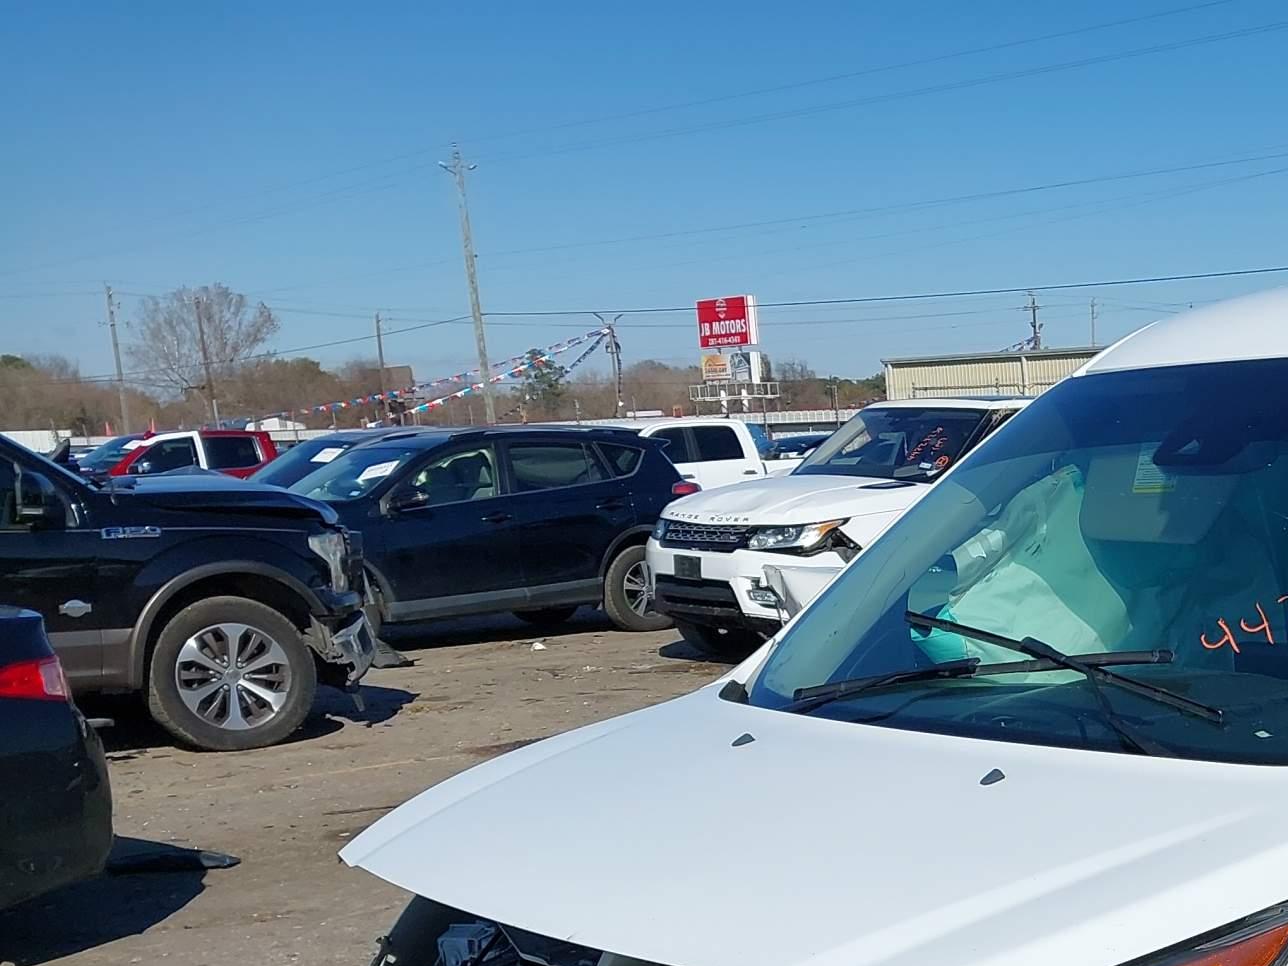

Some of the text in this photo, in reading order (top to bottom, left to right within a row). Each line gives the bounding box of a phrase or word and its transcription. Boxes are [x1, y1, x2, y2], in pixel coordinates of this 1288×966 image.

[701, 319, 746, 337] JB MOTORS
[669, 511, 700, 520] RANGE
